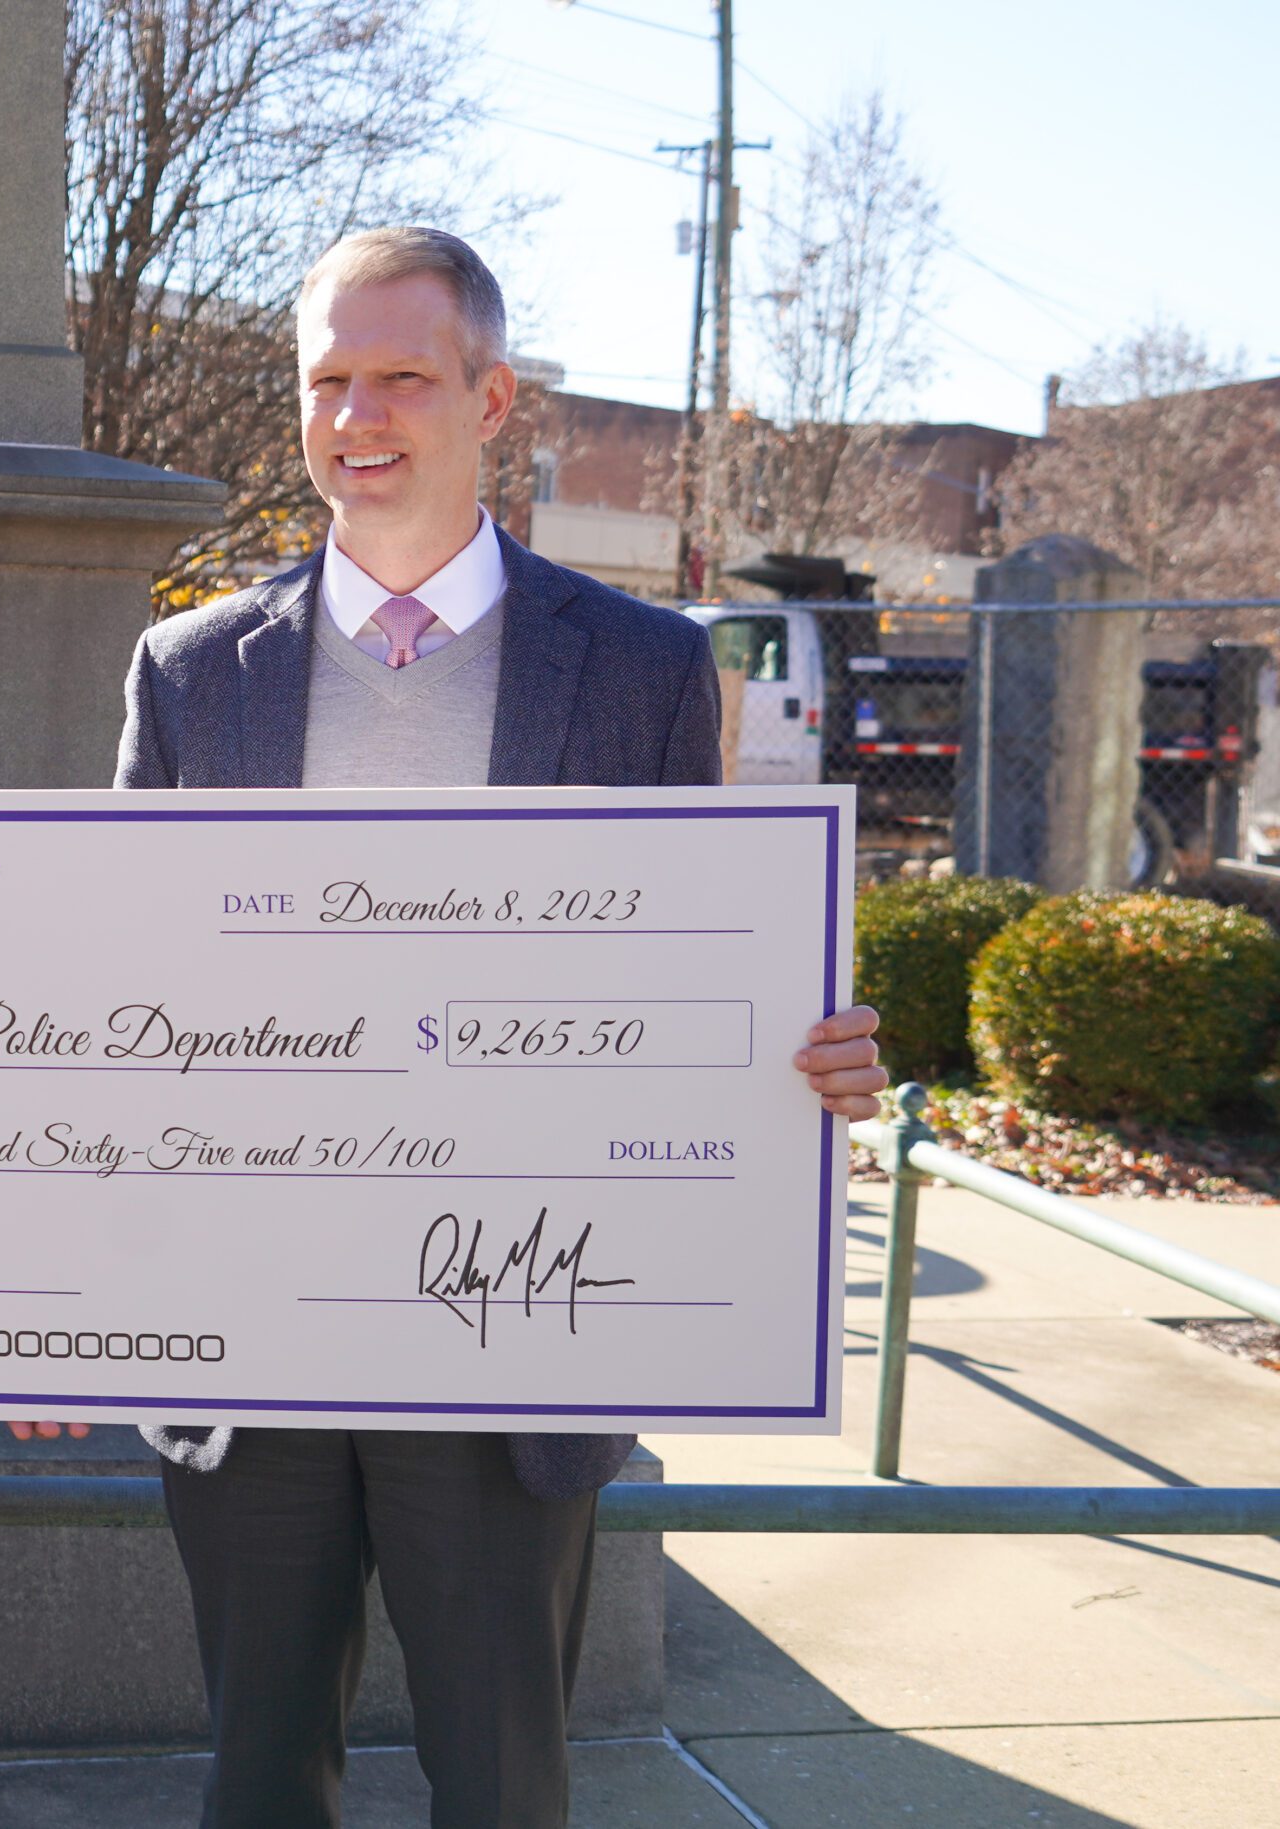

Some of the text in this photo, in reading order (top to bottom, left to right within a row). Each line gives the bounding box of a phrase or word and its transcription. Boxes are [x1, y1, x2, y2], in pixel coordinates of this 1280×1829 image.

[223, 880, 642, 925] DATE December 8, 2023
[103, 1002, 366, 1074] Department
[416, 1013, 644, 1061] $ 9,265.50
[24, 1121, 235, 1179] Sixty-Five
[244, 1135, 305, 1168] and
[307, 1126, 456, 1169] 50/100
[608, 1140, 735, 1161] DOLLARS
